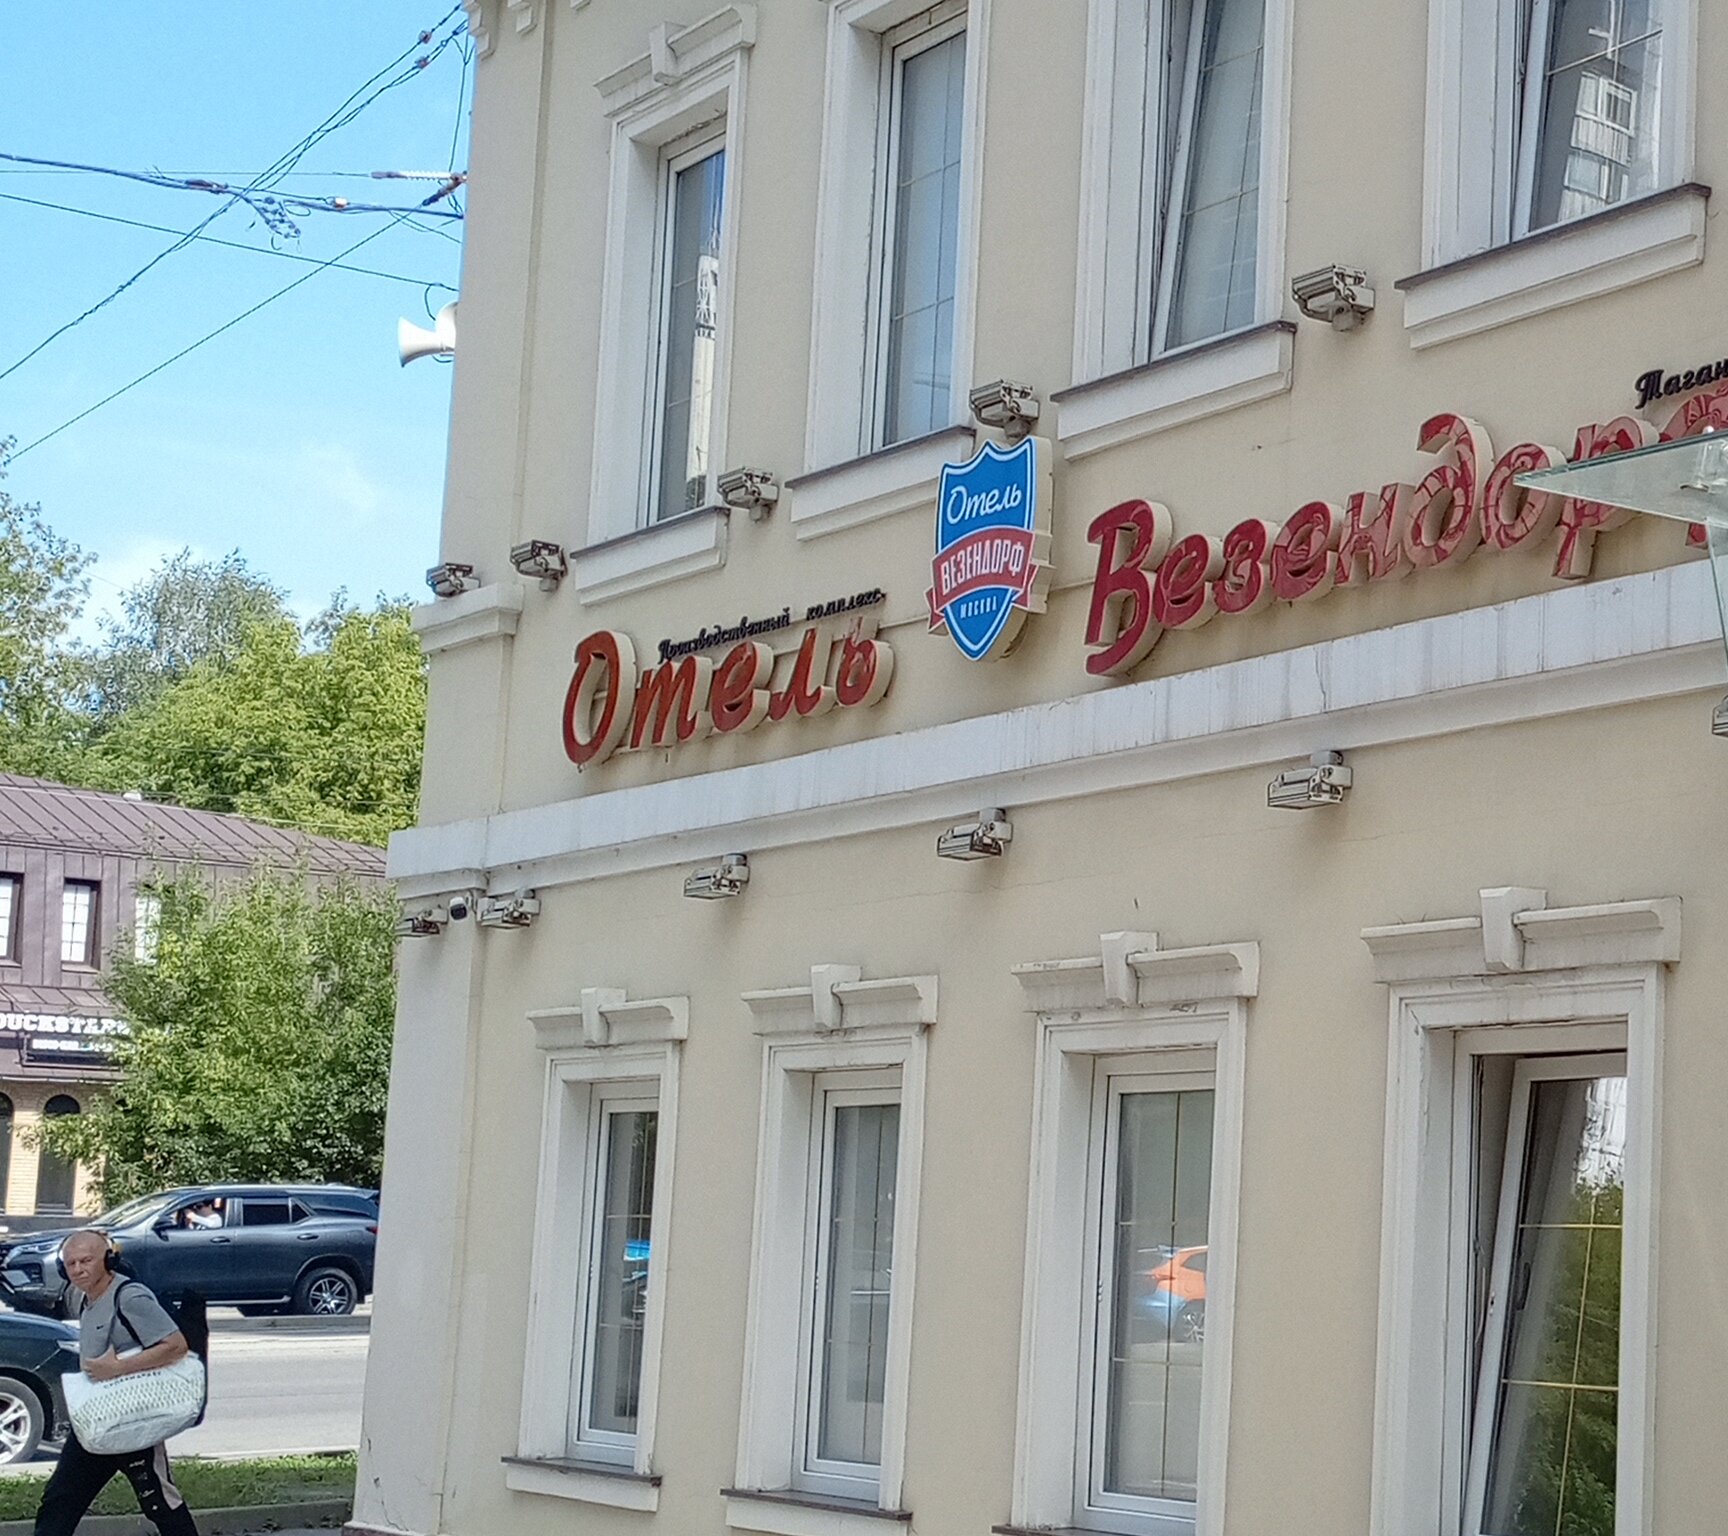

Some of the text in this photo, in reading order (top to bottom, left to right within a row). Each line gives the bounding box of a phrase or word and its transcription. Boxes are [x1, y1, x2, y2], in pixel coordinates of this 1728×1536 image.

[946, 482, 1023, 525] Отель
[940, 538, 1025, 597] ВЕЗЕНДОРФ
[657, 587, 887, 664] Производственный комплекс
[959, 595, 998, 619] МОСКВА
[562, 616, 892, 765] Отель
